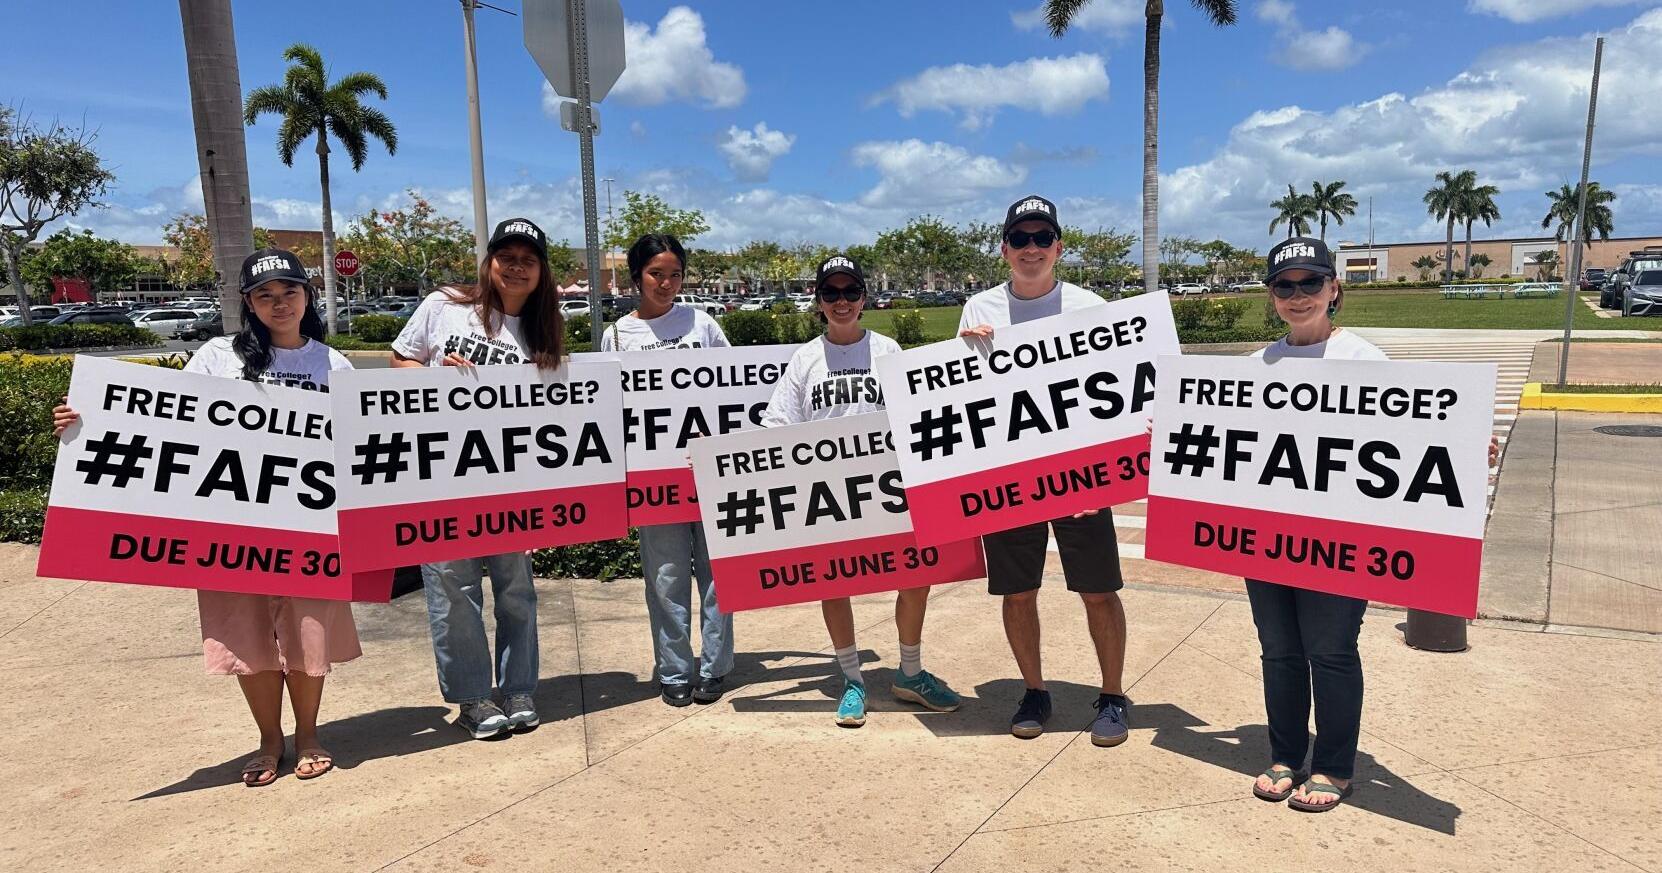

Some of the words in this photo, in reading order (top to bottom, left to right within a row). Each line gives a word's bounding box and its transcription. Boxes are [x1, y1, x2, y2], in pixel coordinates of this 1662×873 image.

[1015, 201, 1050, 215] #FAFSA
[504, 224, 538, 240] #FAFSA
[251, 259, 291, 277] #FAFSA
[304, 265, 323, 279] get
[335, 258, 358, 270] STOP
[822, 258, 855, 273] #FAFSA
[1274, 245, 1316, 265] #FAFSA
[443, 334, 532, 366] #FAFS
[470, 331, 487, 343] Free
[907, 356, 982, 395] FREE
[989, 317, 1147, 374] COLLEGE?
[276, 371, 312, 380] College?
[621, 369, 663, 392] REE
[671, 363, 788, 389] COLLEG
[827, 369, 842, 378] Free
[842, 367, 872, 377] College?
[103, 384, 198, 422] FREE
[208, 401, 332, 441] COLLE
[360, 389, 439, 416] FREE
[448, 380, 600, 410] COLLEGE?
[910, 362, 1156, 461] #FAFSA
[1180, 378, 1254, 407] FREE
[1263, 382, 1458, 420] COLLEGE?
[76, 431, 337, 510] #FAFS
[352, 422, 612, 485] #FAFSA
[716, 447, 785, 477] FREE
[792, 430, 896, 465] COLLE
[1164, 423, 1465, 508] #FAFSA
[626, 485, 680, 510] DUE
[960, 483, 1024, 516] DUE
[1031, 463, 1111, 500] JUNE
[1117, 451, 1150, 480] 30
[717, 470, 909, 537] #FAFS
[396, 518, 458, 546] DUE
[467, 508, 544, 537] JUNE
[553, 503, 586, 527] 30
[110, 534, 189, 564] DUE
[197, 543, 293, 574] JUNE
[301, 551, 341, 577] 30
[760, 563, 816, 589] DUE
[824, 552, 897, 580] JUNE
[903, 546, 939, 569] 30
[1194, 522, 1257, 555] DUE
[1265, 534, 1356, 572] JUNE
[1366, 547, 1415, 580] 30
